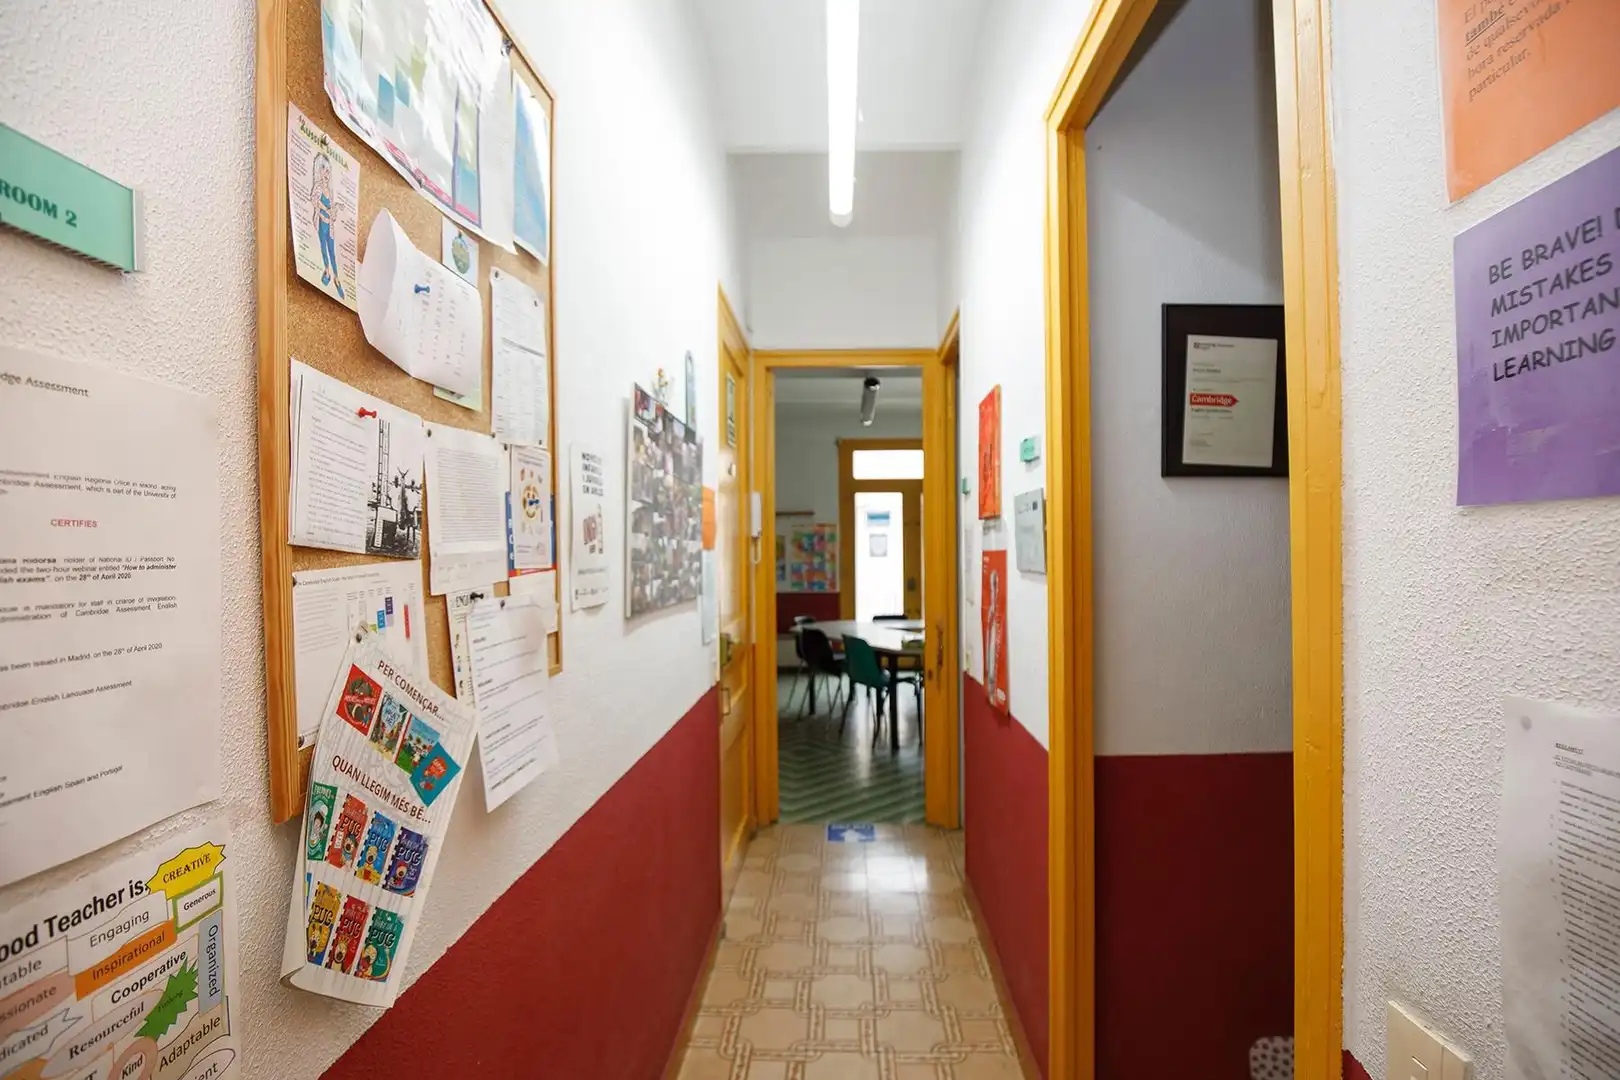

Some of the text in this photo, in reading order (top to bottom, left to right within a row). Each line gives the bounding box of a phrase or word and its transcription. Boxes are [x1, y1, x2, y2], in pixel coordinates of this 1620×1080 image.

[65, 209, 78, 229] 2
[1489, 257, 1513, 285] BE
[1521, 215, 1603, 271] BRAVE!
[1491, 252, 1614, 318] MISTAKES
[1493, 327, 1617, 382] LEARNING
[25, 376, 89, 397] Assessment
[1191, 394, 1233, 405] Cambridge
[50, 518, 97, 528] CERTIFIES
[377, 659, 395, 681] PER
[331, 754, 361, 783] QUAN
[360, 772, 391, 803] LLEGIM
[391, 791, 412, 814] MÉS
[162, 852, 212, 884] CREATIVE
[396, 845, 422, 866] PUG
[44, 888, 125, 938] Teacher
[183, 888, 217, 911] Generous
[312, 904, 333, 927] PUG
[89, 910, 150, 948] Engaging
[91, 930, 166, 981] Inspirational
[206, 924, 221, 998] Organized
[110, 950, 187, 1005] Cooperative
[68, 1001, 145, 1060] Resourceful
[159, 1016, 221, 1073] Adaptable
[121, 1054, 143, 1080] Kind
